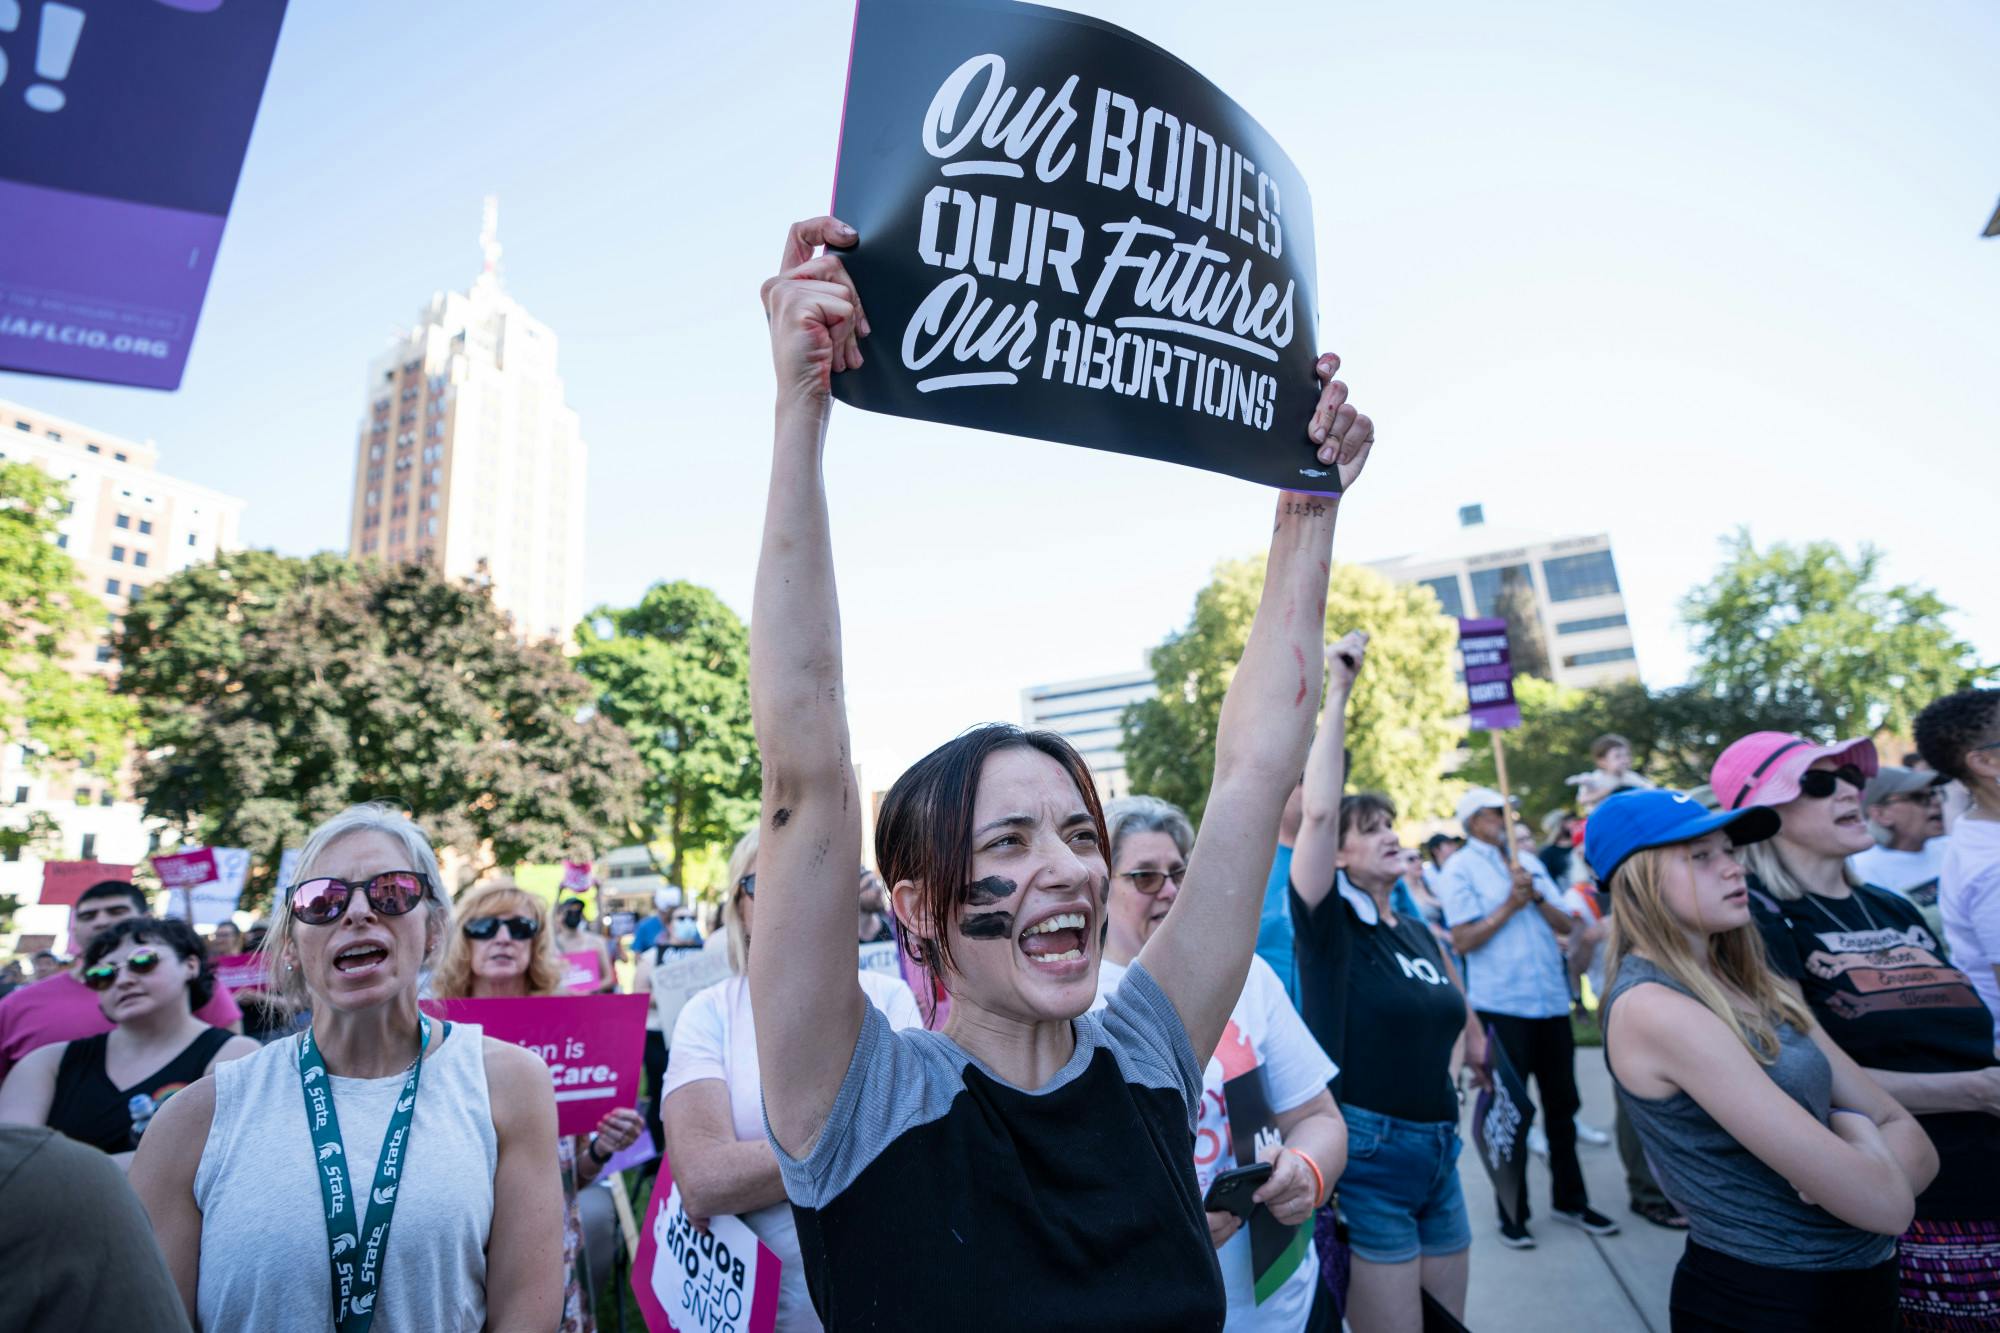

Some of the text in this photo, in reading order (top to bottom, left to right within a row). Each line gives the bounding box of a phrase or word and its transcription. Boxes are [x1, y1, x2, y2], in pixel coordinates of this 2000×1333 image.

[922, 53, 1283, 259] Our BODIES
[918, 186, 1295, 349] OUR Futures
[901, 274, 1276, 431] Our ABORTIONS
[1395, 952, 1449, 985] NO.
[549, 1063, 618, 1087] Care.
[564, 1037, 585, 1060] is
[308, 1087, 330, 1131] State
[384, 1126, 409, 1180] State
[324, 1165, 346, 1219] State
[361, 1223, 388, 1286] State
[667, 1217, 700, 1279] OUR
[700, 1268, 742, 1321] OFF
